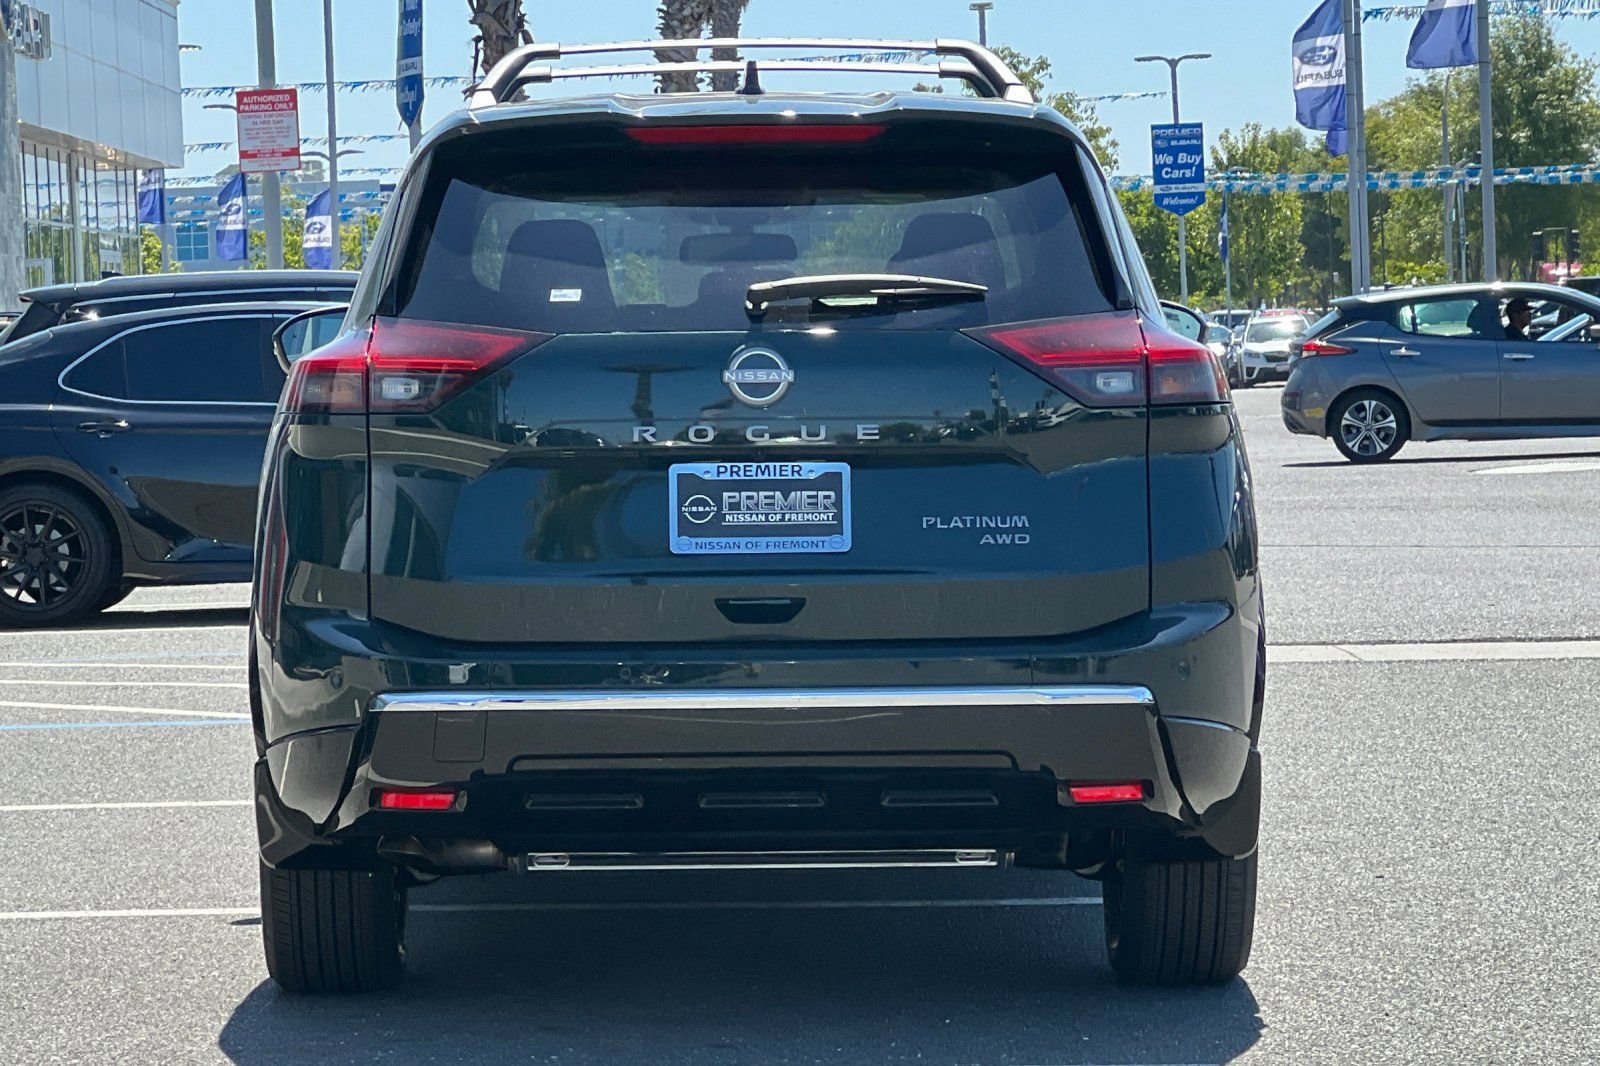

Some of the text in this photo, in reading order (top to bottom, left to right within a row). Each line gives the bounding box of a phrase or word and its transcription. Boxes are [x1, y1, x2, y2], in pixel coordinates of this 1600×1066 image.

[242, 94, 290, 104] AUTHORIZED
[240, 102, 294, 112] PARKING ONLY
[1154, 152, 1202, 165] We Buy
[1161, 166, 1196, 178] Cars!
[1162, 196, 1199, 205] Welcome!
[725, 370, 793, 381] NISSAN
[632, 424, 881, 443] ROGUE
[716, 465, 803, 478] PREMIER
[722, 491, 837, 511] PREMIER
[725, 513, 834, 522] NISSAN OF FREMONT
[922, 516, 1030, 528] PLATINUM
[980, 534, 1031, 544] AWD
[694, 540, 827, 550] NISSAN OF FREMONT
